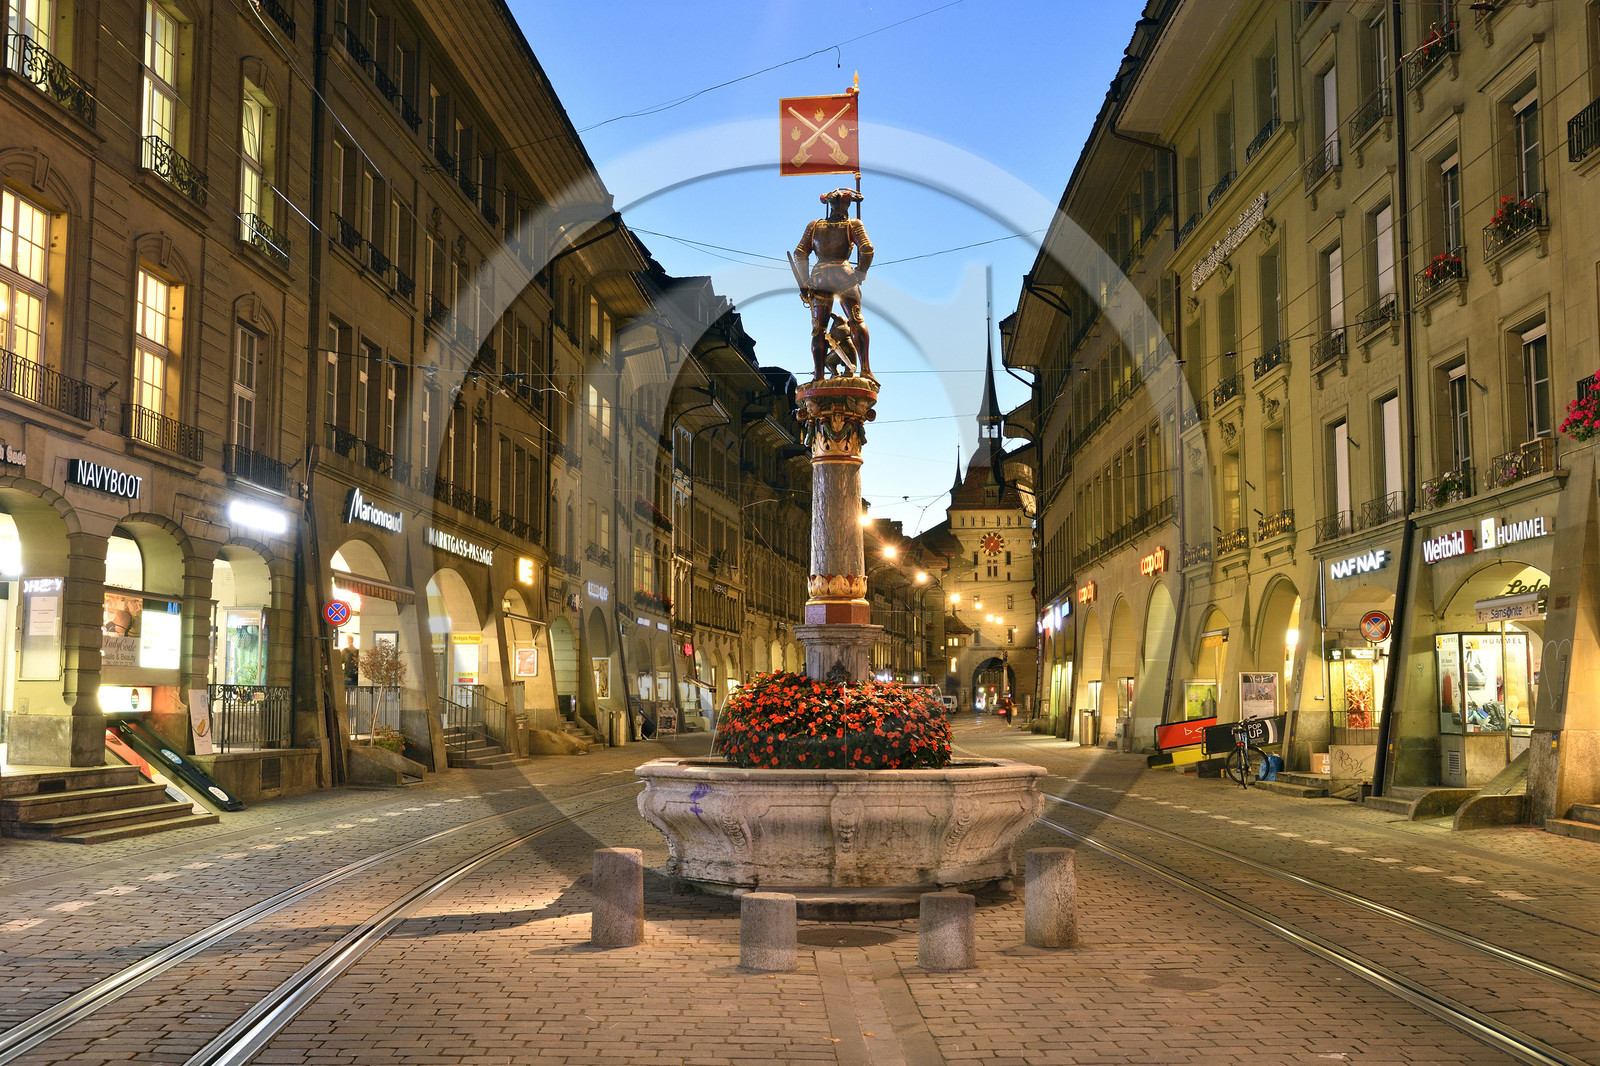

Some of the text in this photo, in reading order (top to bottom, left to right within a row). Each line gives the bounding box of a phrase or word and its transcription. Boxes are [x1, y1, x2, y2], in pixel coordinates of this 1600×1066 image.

[77, 459, 143, 499] NAVYBOOT
[349, 487, 403, 533] Marionnaud
[1497, 516, 1548, 545] HUMMEL
[428, 527, 493, 567] MARKTGASS-PASSAGE
[1141, 545, 1165, 576] coop city
[1423, 530, 1465, 562] Weltbild
[1331, 550, 1385, 580] NAF NAF
[1490, 606, 1523, 620] Samsonite
[1247, 722, 1262, 731] POP
[1249, 728, 1263, 739] UP
